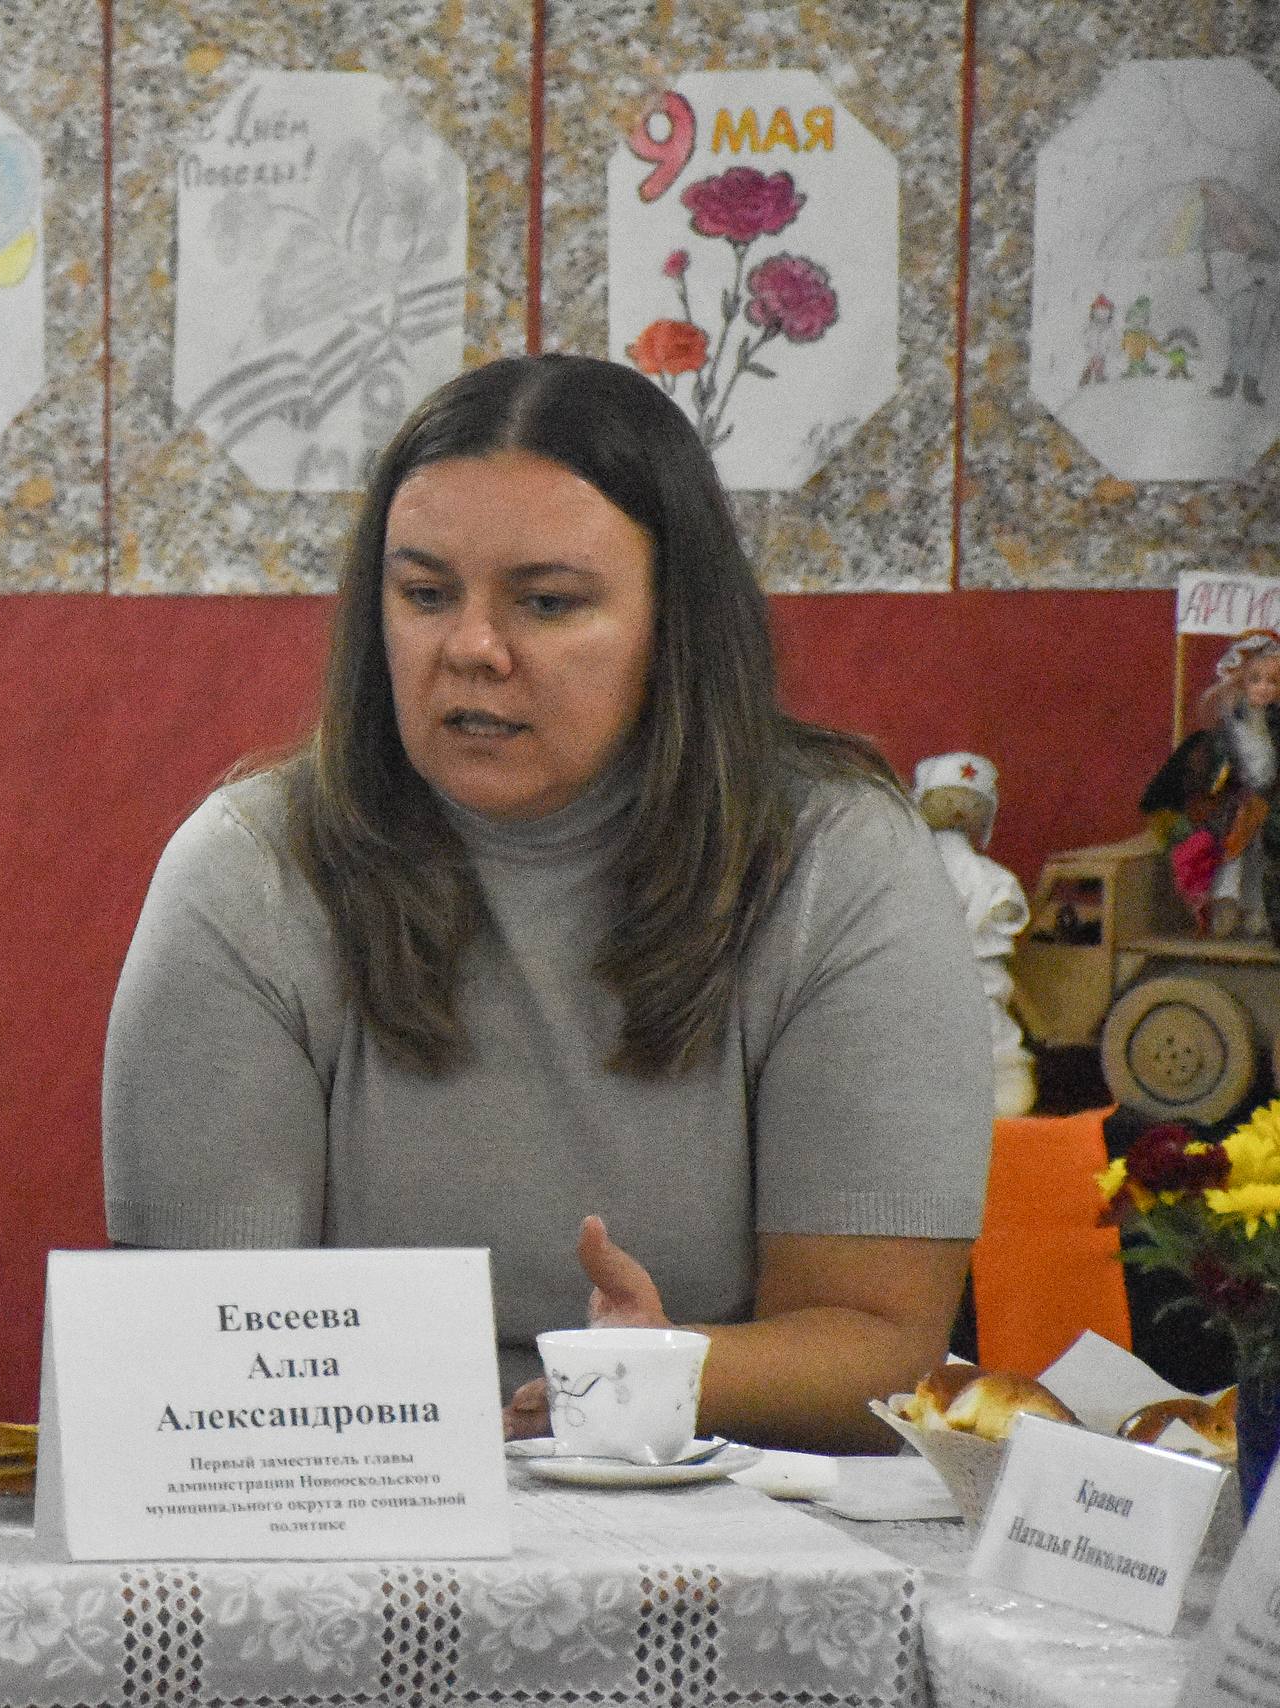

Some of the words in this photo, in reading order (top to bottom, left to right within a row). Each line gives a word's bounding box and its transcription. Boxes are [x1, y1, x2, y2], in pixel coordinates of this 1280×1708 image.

[630, 90, 696, 203] 9
[711, 106, 833, 154] МАЯ
[217, 1304, 360, 1332] Евсеева
[247, 1352, 340, 1379] Алла
[156, 1400, 440, 1433] Александровна
[190, 1455, 256, 1473] Первый
[259, 1452, 359, 1469] заместитель
[363, 1452, 414, 1466] главы
[167, 1477, 295, 1495] администрации
[300, 1472, 442, 1489] Новооскольского
[145, 1499, 284, 1519] муниципального
[287, 1496, 343, 1514] округа
[347, 1497, 366, 1508] по
[370, 1492, 467, 1508] социальной
[1073, 1478, 1134, 1518] Кравец
[269, 1518, 347, 1533] политике
[1007, 1515, 1072, 1557] Наталья
[1071, 1534, 1168, 1587] Николаевна
